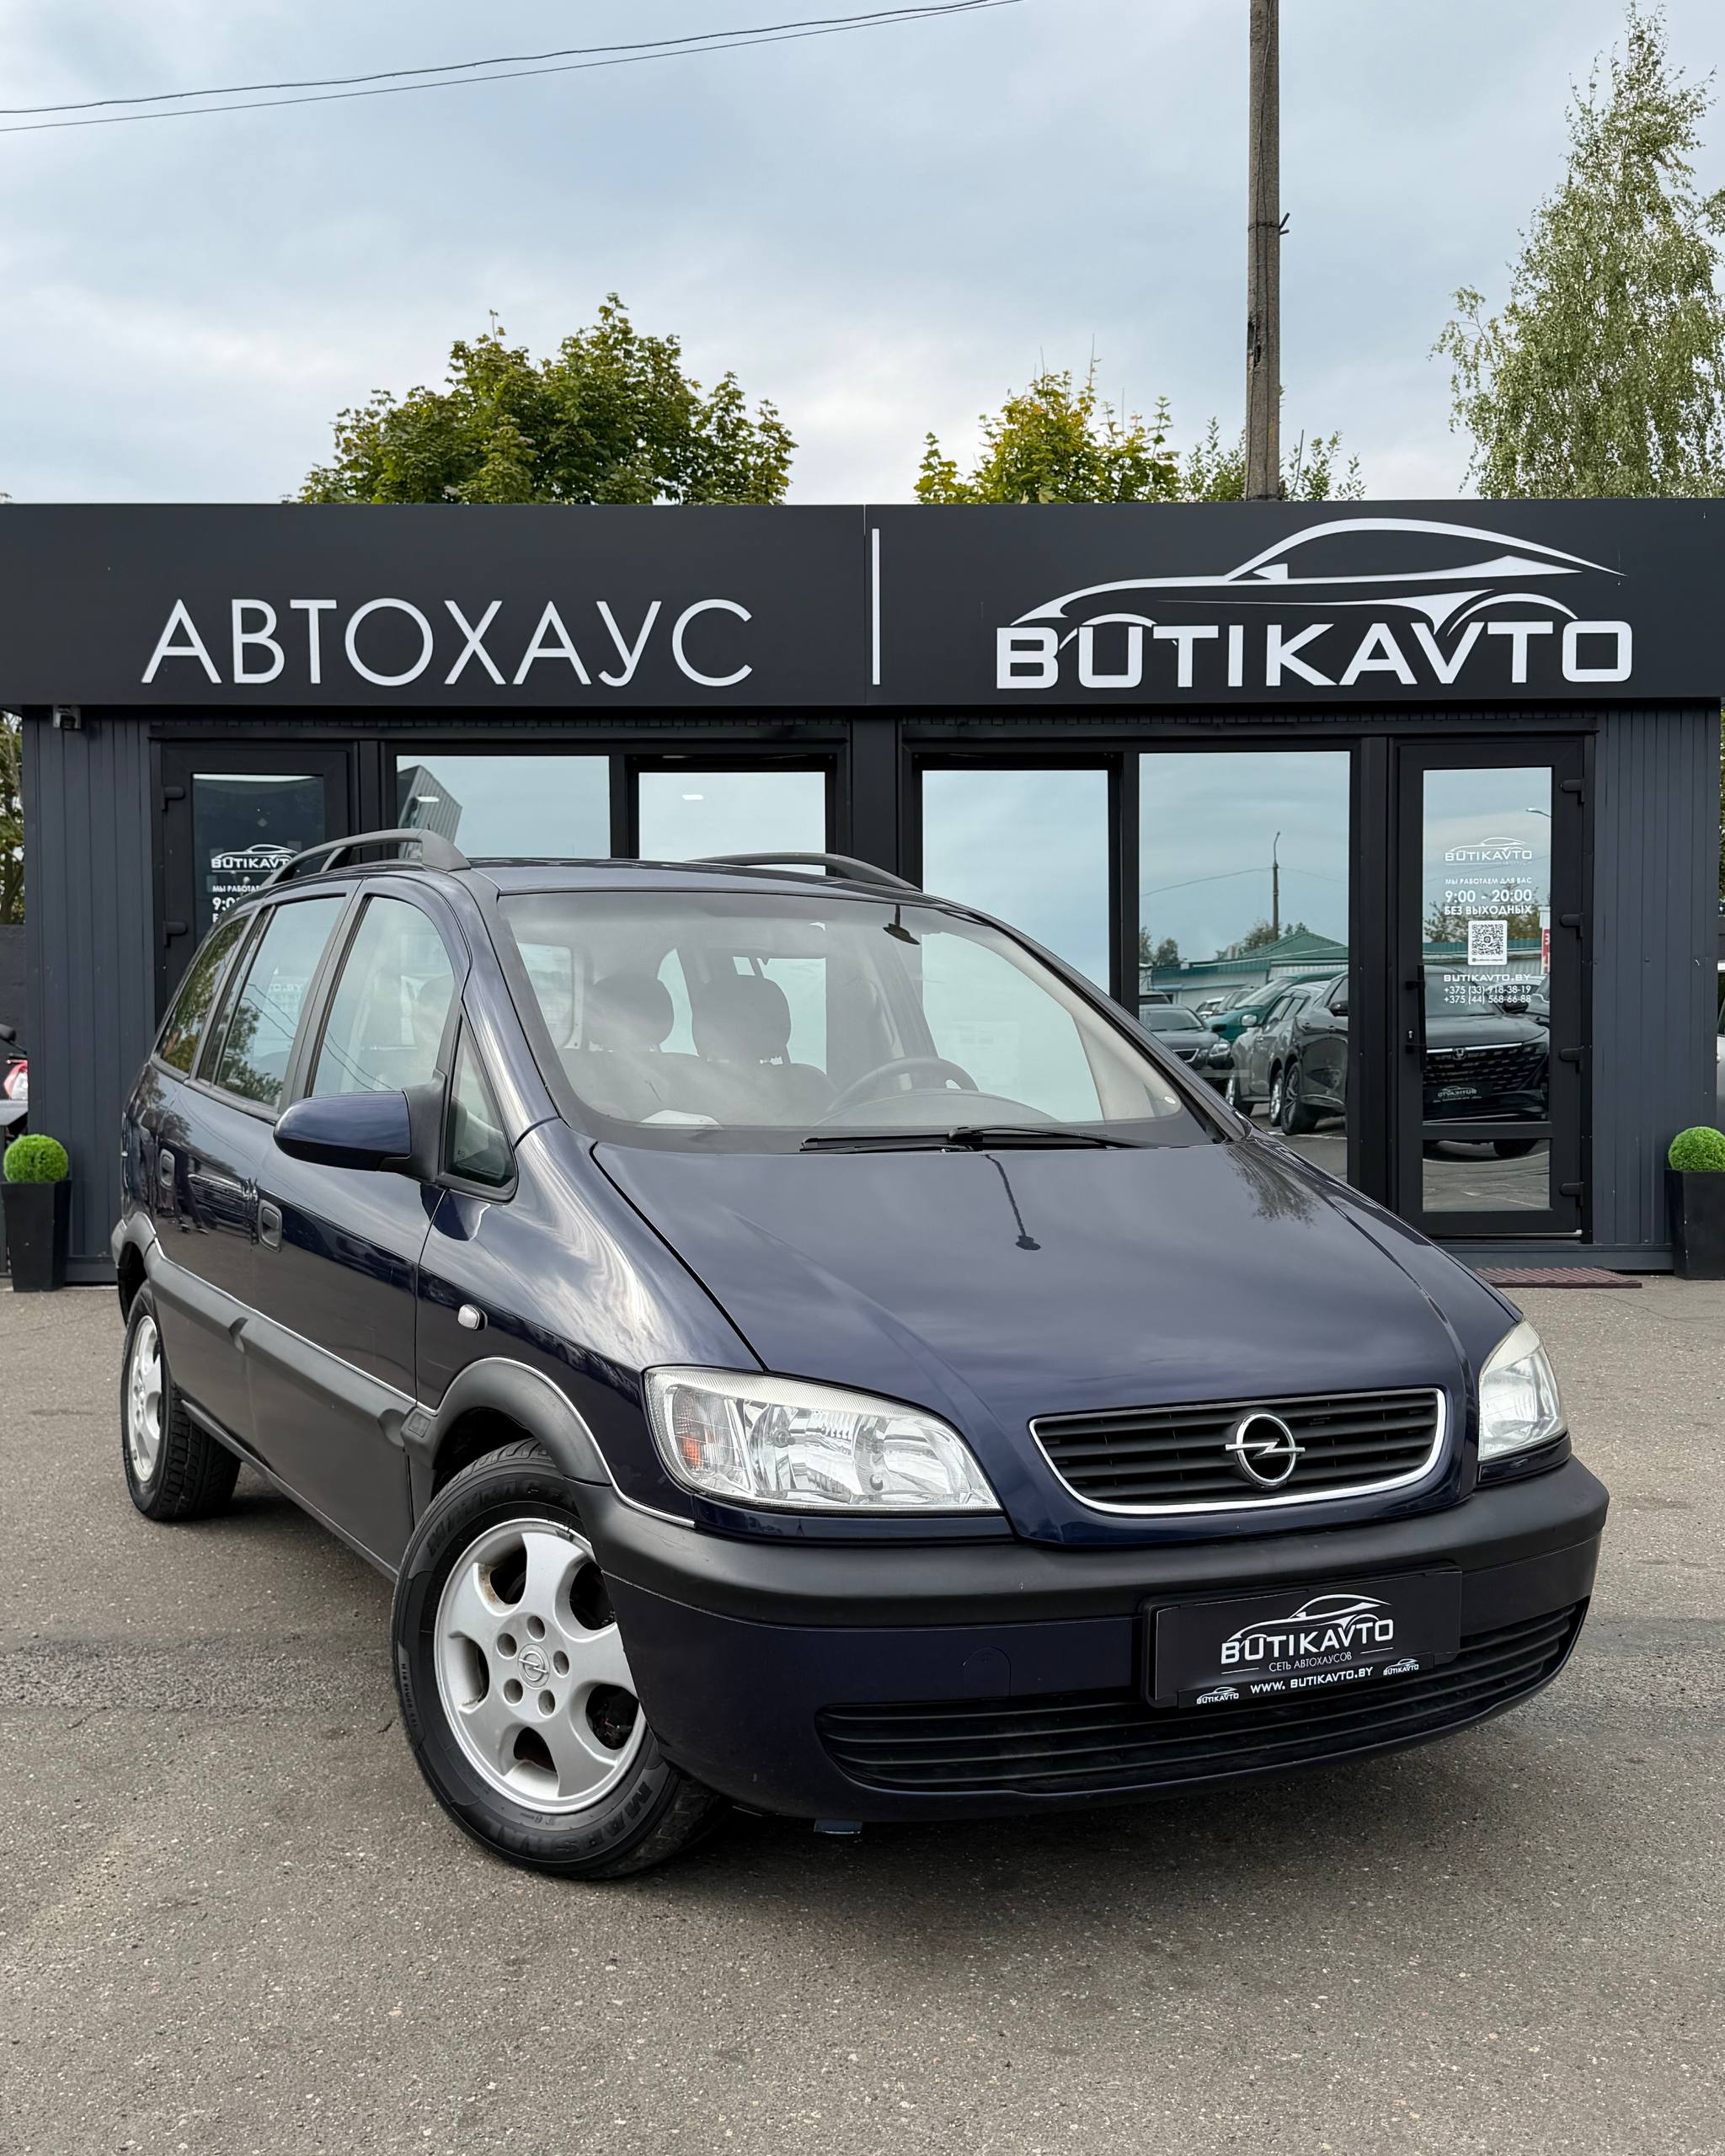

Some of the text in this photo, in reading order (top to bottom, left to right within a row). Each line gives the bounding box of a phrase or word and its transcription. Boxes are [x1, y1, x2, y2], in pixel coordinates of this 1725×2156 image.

[141, 597, 754, 687] АВТОХАУС
[996, 619, 1634, 690] BUTIKAVTO
[1444, 850, 1533, 862] BUTIKAVTO
[211, 857, 292, 869] BUTIKAVT
[1445, 889, 1476, 903] 9:00
[1491, 889, 1532, 903] 20:00
[1444, 905, 1532, 915] БЕЗ ВЫХОДНЫХ
[1443, 974, 1531, 982] BUTIKAVTO.BY
[1444, 985, 1466, 994] +375
[1468, 985, 1485, 995] (33)
[1444, 995, 1531, 1005] +375 (44) 568-66-88
[1220, 1618, 1394, 1664] BUTIKAVTO
[1268, 1652, 1353, 1673] СЕТЬ АВТОХАУСОВ
[1383, 1662, 1419, 1676] BUTIKAVTO
[1250, 1667, 1374, 1694] WWW. BUTIKAVTO.BY
[1196, 1692, 1239, 1705] BUTIKAVTO
